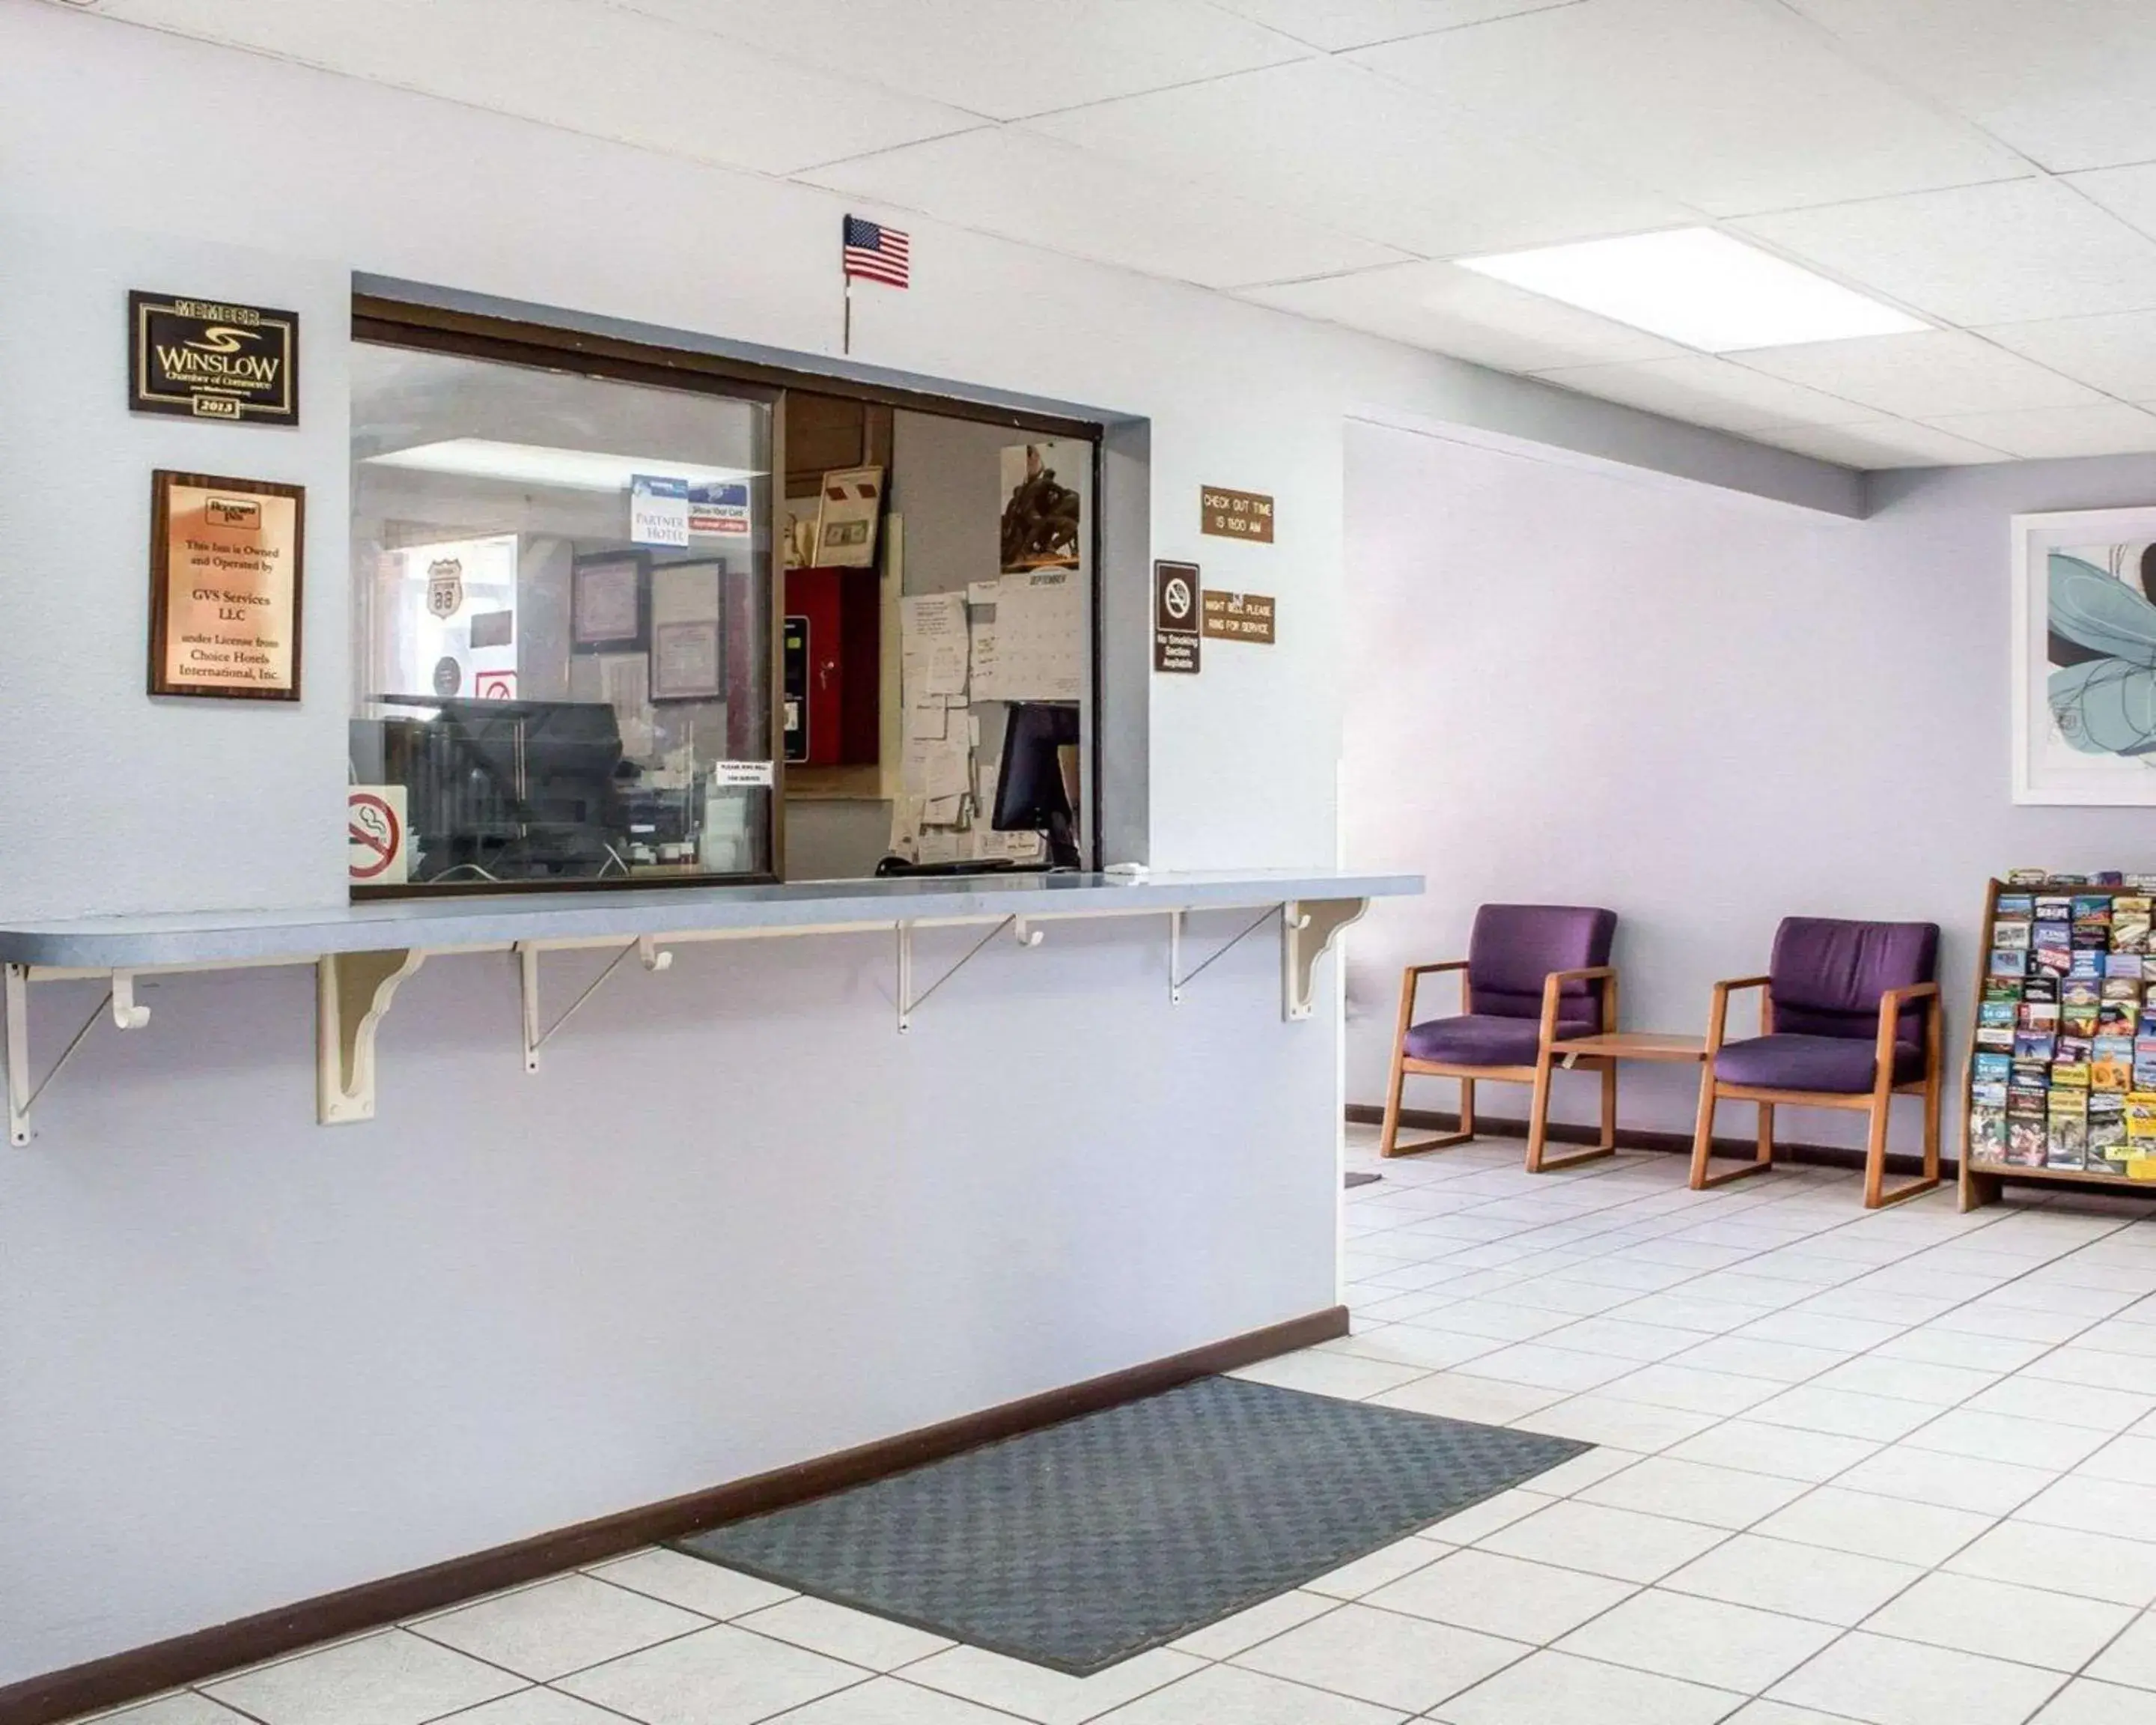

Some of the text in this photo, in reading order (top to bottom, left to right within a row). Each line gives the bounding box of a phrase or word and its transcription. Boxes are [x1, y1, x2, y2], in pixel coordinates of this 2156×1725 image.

[174, 299, 260, 326] MEMBER
[156, 344, 280, 382] WINSLOW
[165, 371, 272, 390] Chamber of Commerce
[1203, 493, 1273, 517] CHECK OUT TIME
[636, 512, 684, 527] PARTNER
[1216, 515, 1225, 529] IS
[1249, 521, 1261, 533] AM
[647, 526, 686, 541] HOTEL
[186, 539, 279, 559] This Inn is Owned
[191, 556, 273, 574] and Operated by
[192, 588, 271, 606] GVS Services
[219, 608, 246, 621] LLC
[1246, 604, 1272, 618] PLEASE
[1226, 619, 1240, 631] FOR
[1241, 621, 1270, 635] SERVICE
[181, 634, 279, 648] under License from
[1157, 633, 1199, 648] No Smoking
[190, 648, 270, 664] Choice Hotels
[1163, 655, 1194, 669] Available
[179, 663, 278, 680] International, Inc.
